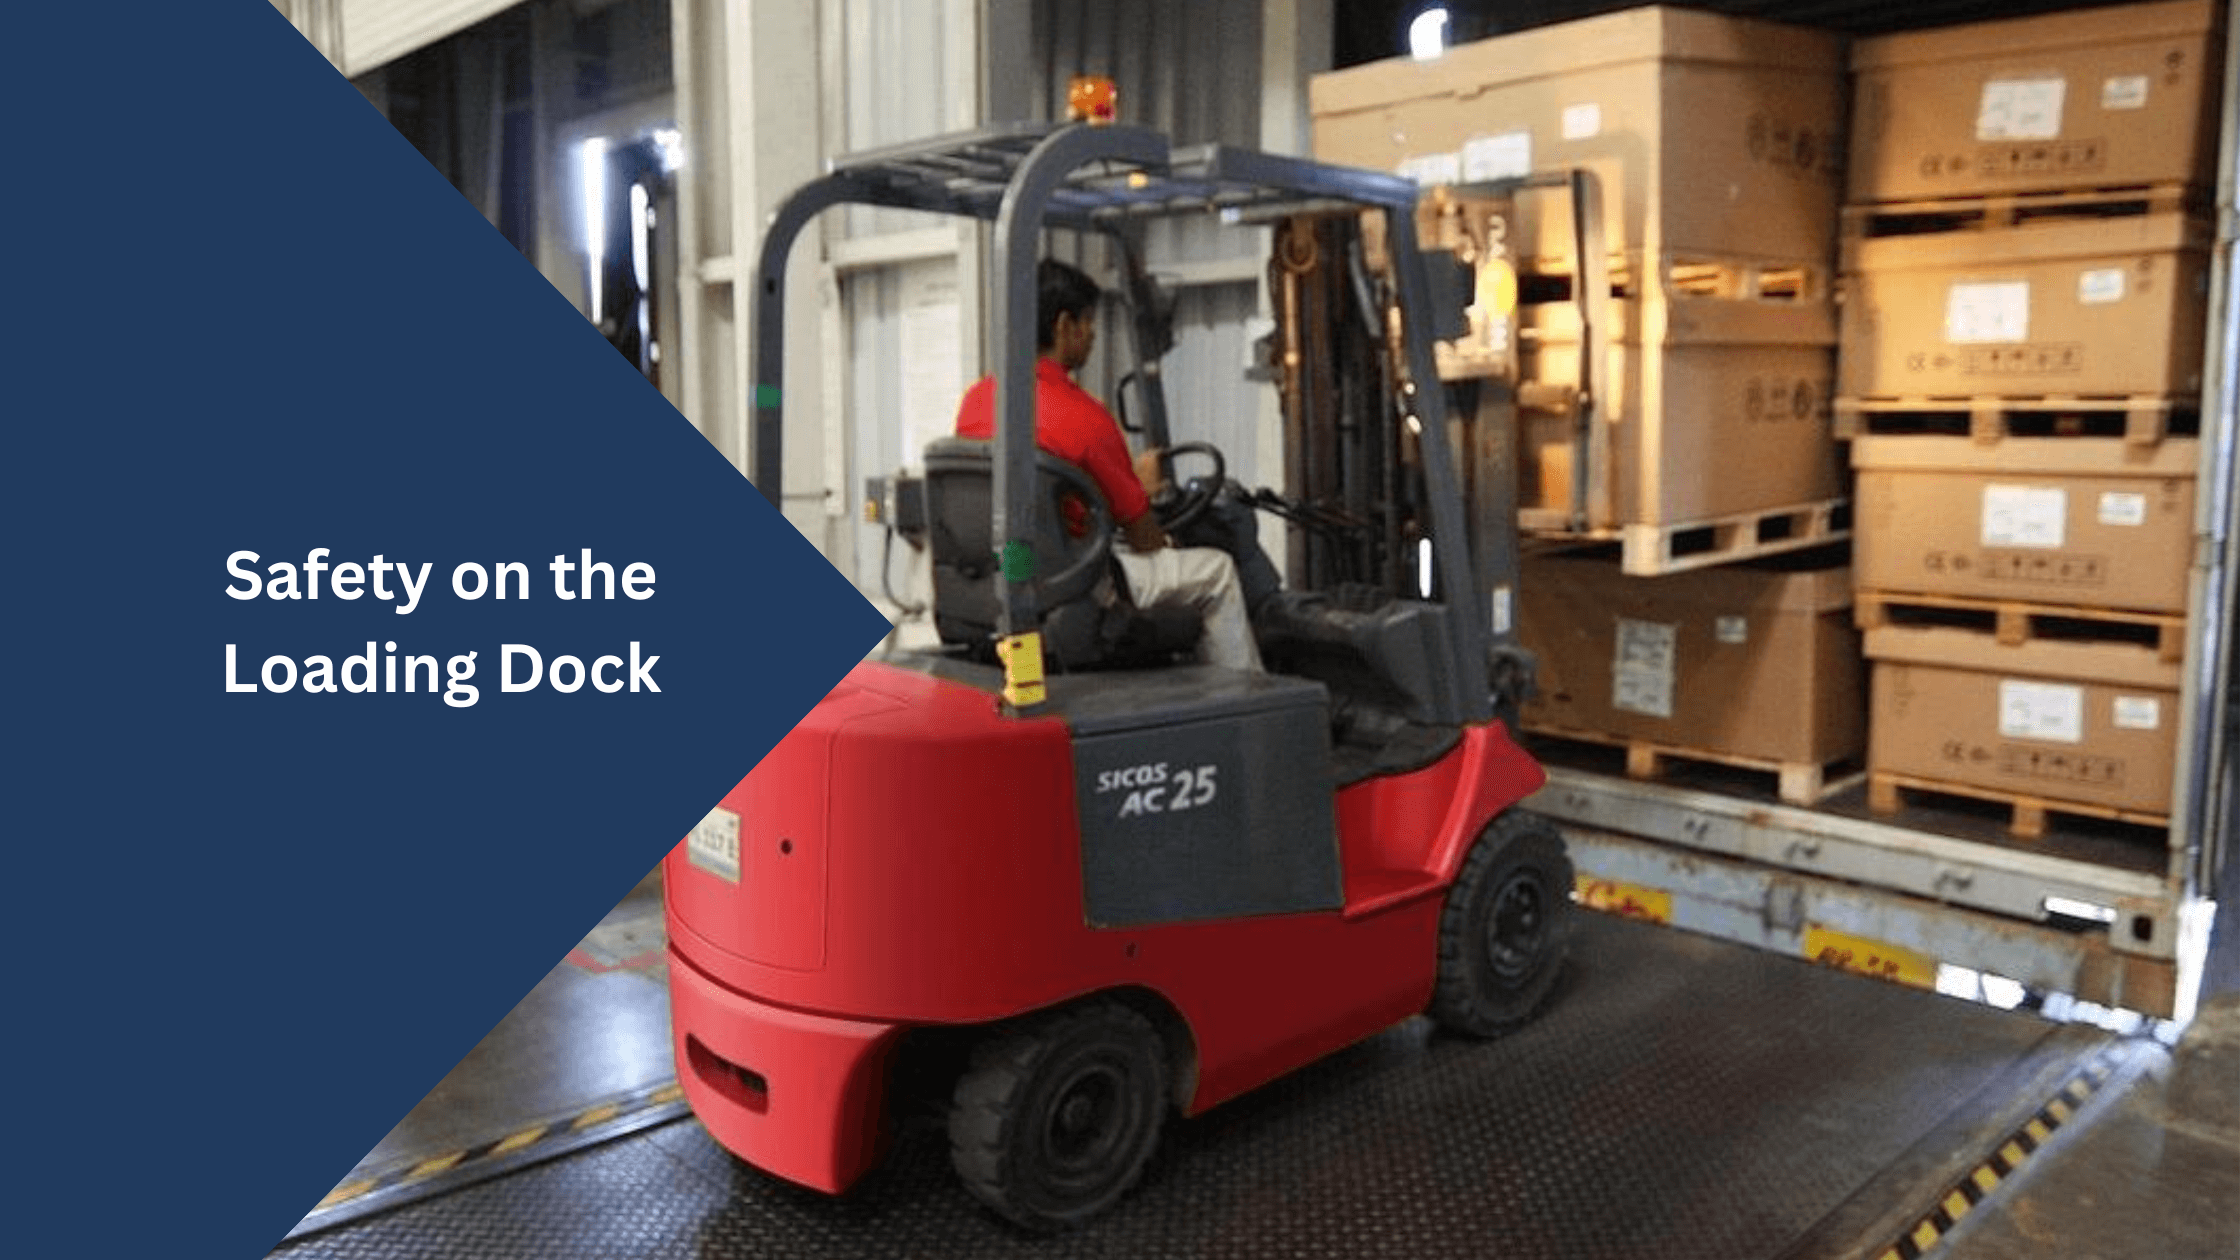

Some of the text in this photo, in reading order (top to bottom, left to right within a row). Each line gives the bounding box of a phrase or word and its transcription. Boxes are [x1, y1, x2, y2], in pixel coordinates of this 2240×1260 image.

[1097, 762, 1168, 793] SICOS
[1119, 765, 1217, 818] AC 25
